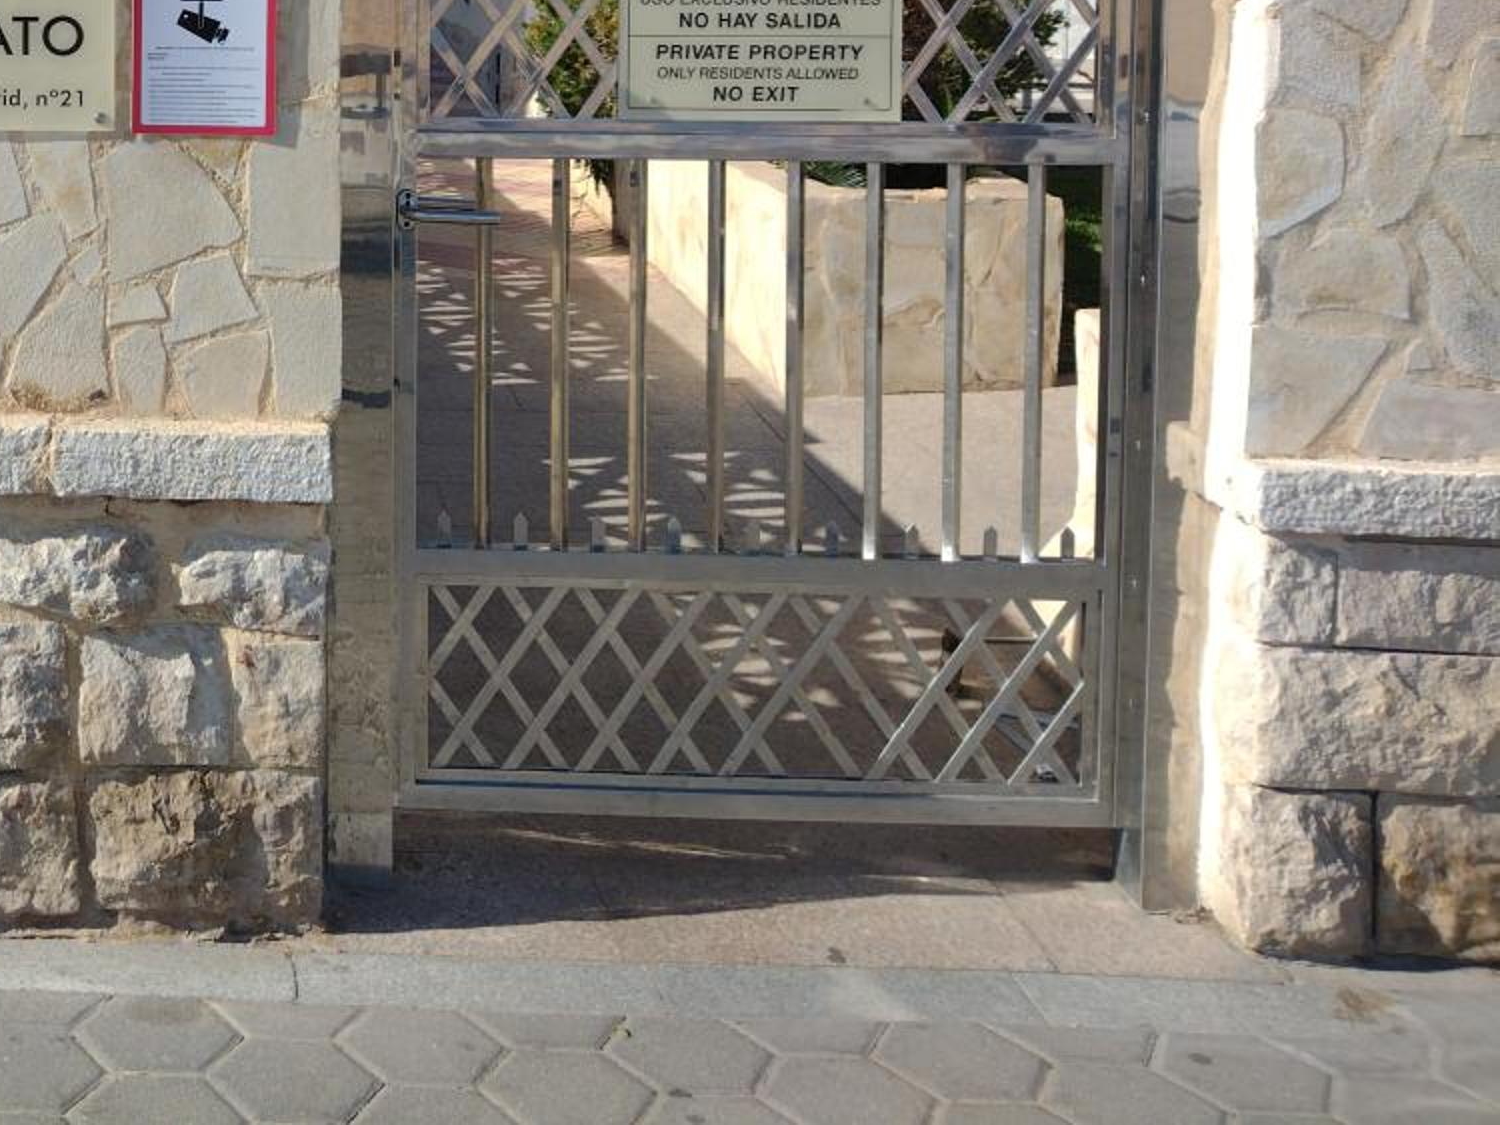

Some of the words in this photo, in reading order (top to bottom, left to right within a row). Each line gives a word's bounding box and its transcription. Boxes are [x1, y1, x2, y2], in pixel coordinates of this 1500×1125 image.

[679, 12, 709, 28] NO
[718, 12, 758, 28] HAY
[765, 12, 841, 29] SALIDA
[656, 44, 740, 60] PRIVATE
[749, 44, 863, 61] PROPERTY
[657, 66, 696, 80] ONLY
[699, 66, 783, 80] RESIDENTS
[785, 66, 859, 80] ALLOWED
[713, 86, 743, 102] NO
[752, 86, 799, 102] EXIT
